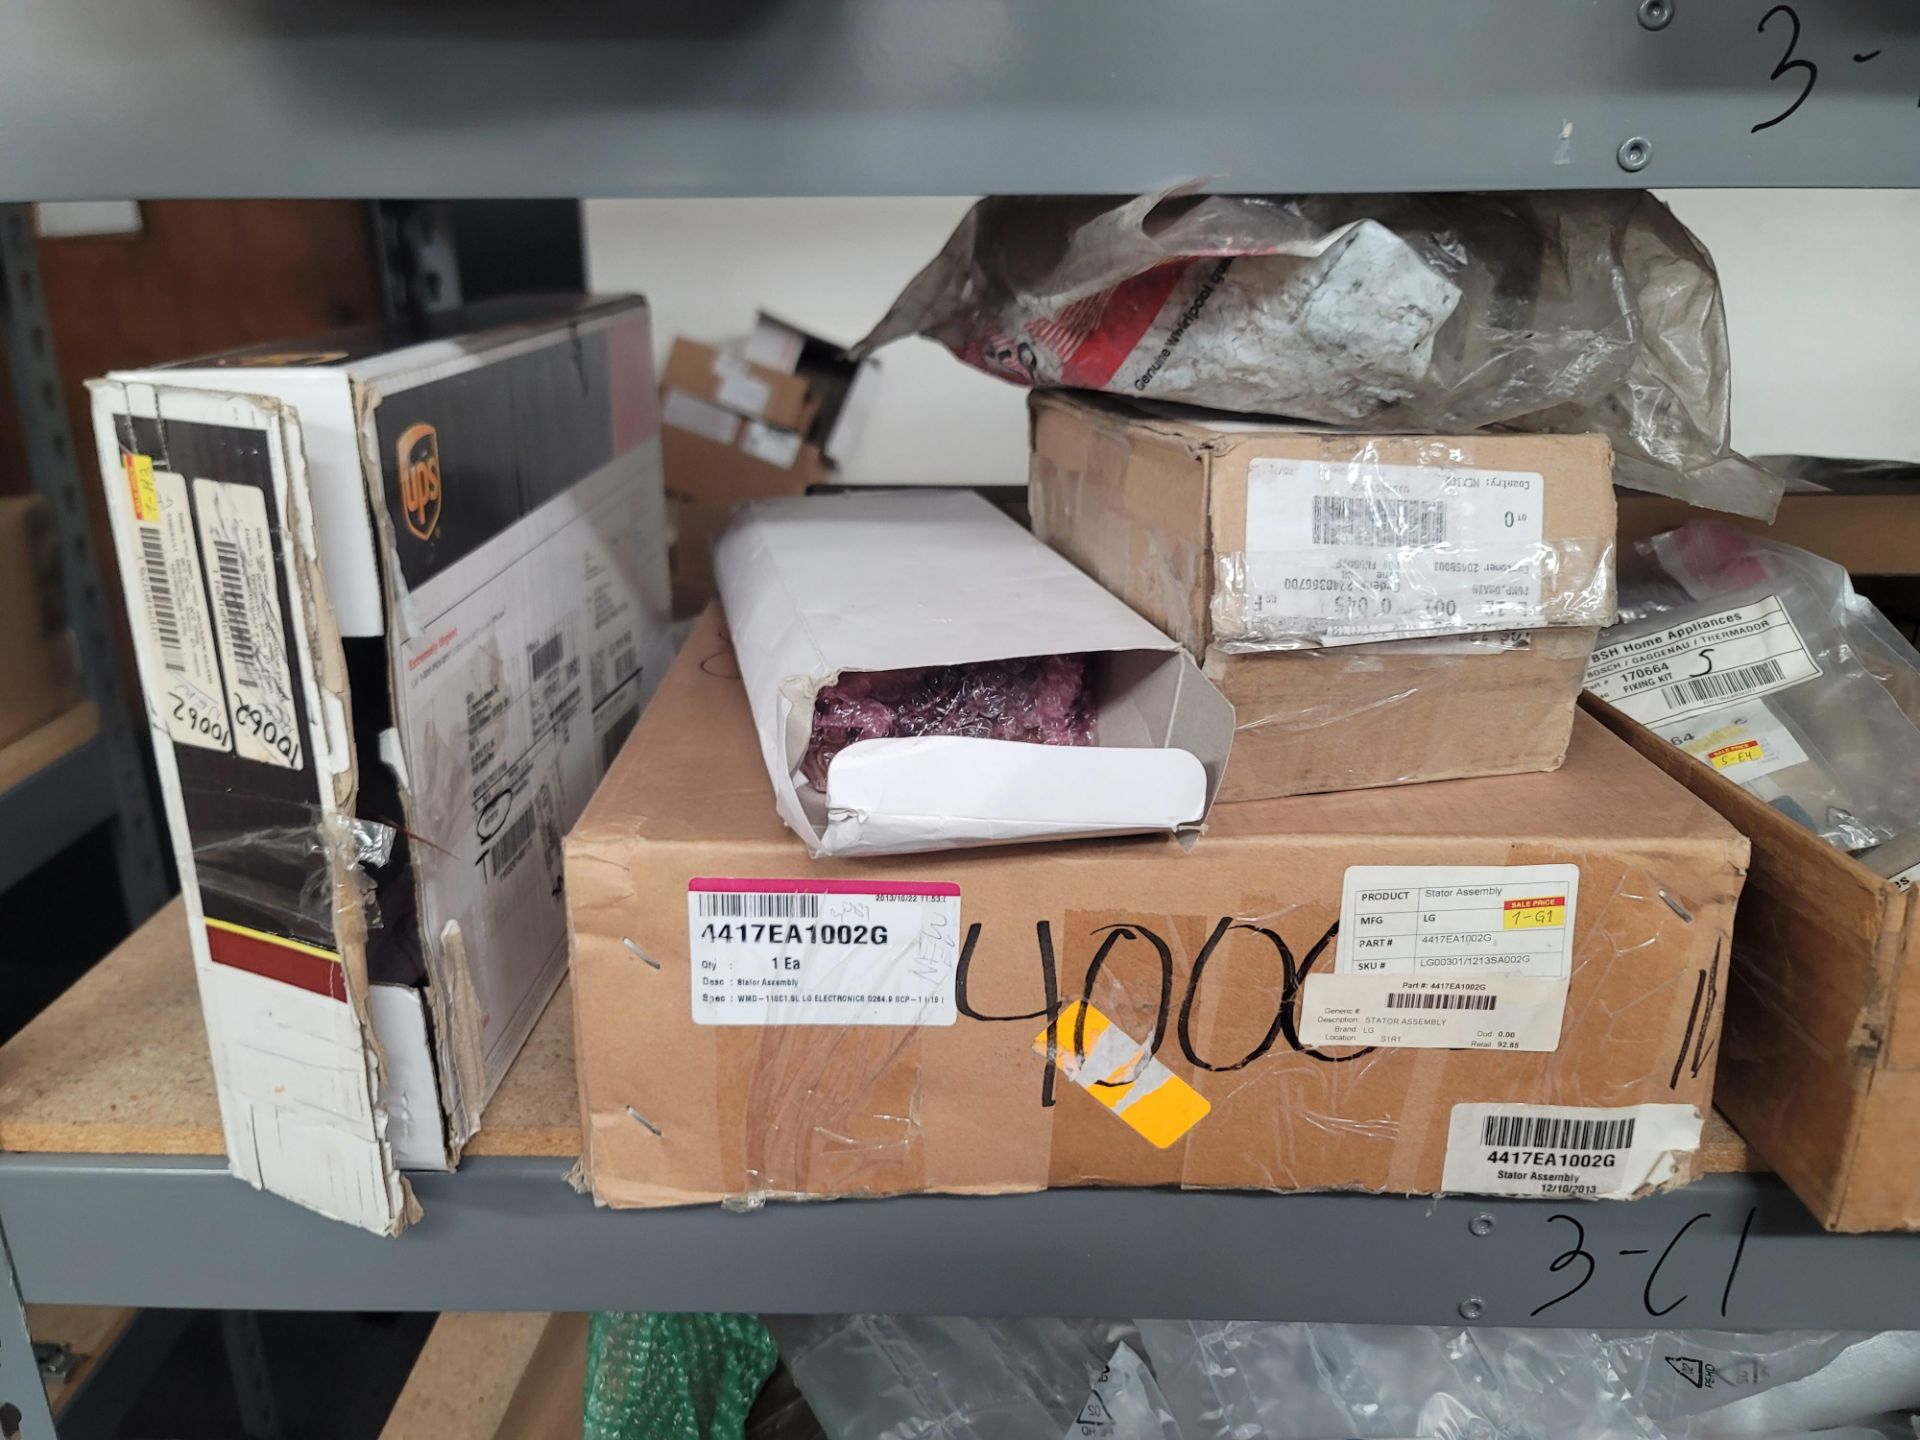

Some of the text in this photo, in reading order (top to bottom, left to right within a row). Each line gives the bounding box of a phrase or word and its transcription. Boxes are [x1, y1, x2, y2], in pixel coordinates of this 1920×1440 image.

[1752, 5, 1920, 134] 3-
[1134, 348, 1171, 391] Genuine
[1165, 284, 1213, 348] Whirlpool
[401, 456, 438, 525] ups
[1486, 477, 1530, 490] Country:
[1591, 612, 1742, 663] BSH Home Appliances
[1587, 663, 1621, 678] BOSCH
[1632, 643, 1690, 665] GAGGENAU
[1702, 620, 1770, 644] THERMADOR
[1621, 662, 1670, 683] 170664
[1624, 672, 1673, 694] FIXING KIT
[1362, 887, 1503, 902] PRODUCT Stator Assembly
[1511, 898, 1555, 909] SALE PRICE
[1360, 914, 1436, 926] MFG LG
[701, 923, 888, 945] 4417EA1002G
[1359, 934, 1492, 948] PART # 4417EA1002G
[702, 961, 717, 971] Qty
[772, 957, 778, 970] 1
[785, 957, 800, 970] Ea
[1357, 962, 1378, 971] SKU
[1420, 955, 1530, 967] LG00301/1213SA002G
[761, 978, 799, 988] Assembly
[1430, 983, 1486, 991] 4417EA1002G
[815, 995, 865, 1003] ELECTRONICS
[1324, 1007, 1353, 1015] Generic
[1364, 1017, 1399, 1025] STATOR
[1400, 1018, 1448, 1026] ASSEMBLY
[1498, 1031, 1516, 1039] 0.00
[1487, 1151, 1616, 1168] 4417EA1002G
[1497, 1170, 1580, 1183] Stator Assembly
[1541, 1184, 1597, 1195] 12/10/2013
